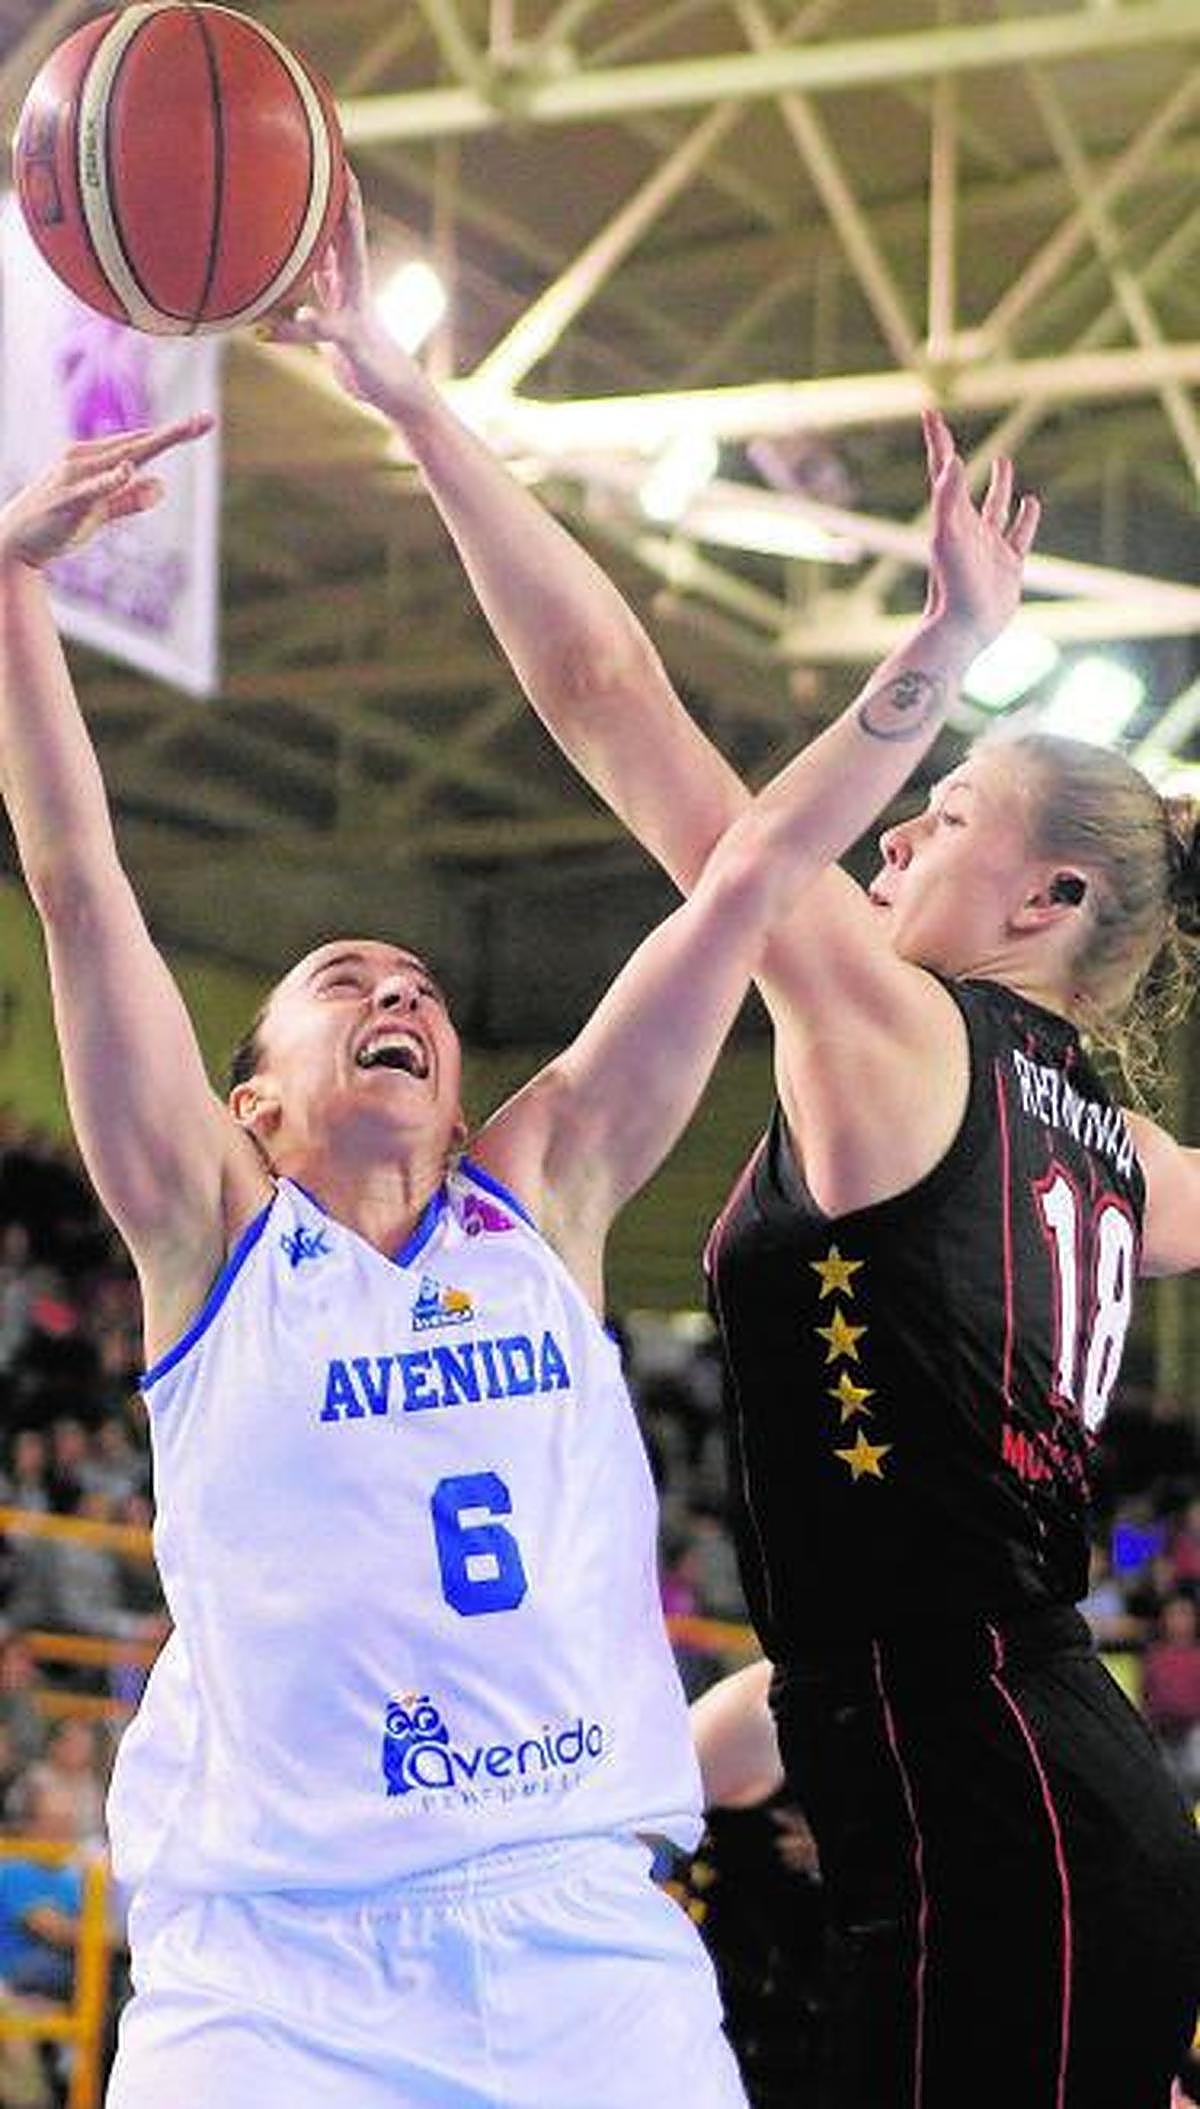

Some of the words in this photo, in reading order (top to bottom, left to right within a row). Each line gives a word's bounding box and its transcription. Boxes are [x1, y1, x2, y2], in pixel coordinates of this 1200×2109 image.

[1036, 1166, 1137, 1432] 18
[319, 1330, 572, 1422] AVENIDA
[431, 1471, 528, 1617] 6
